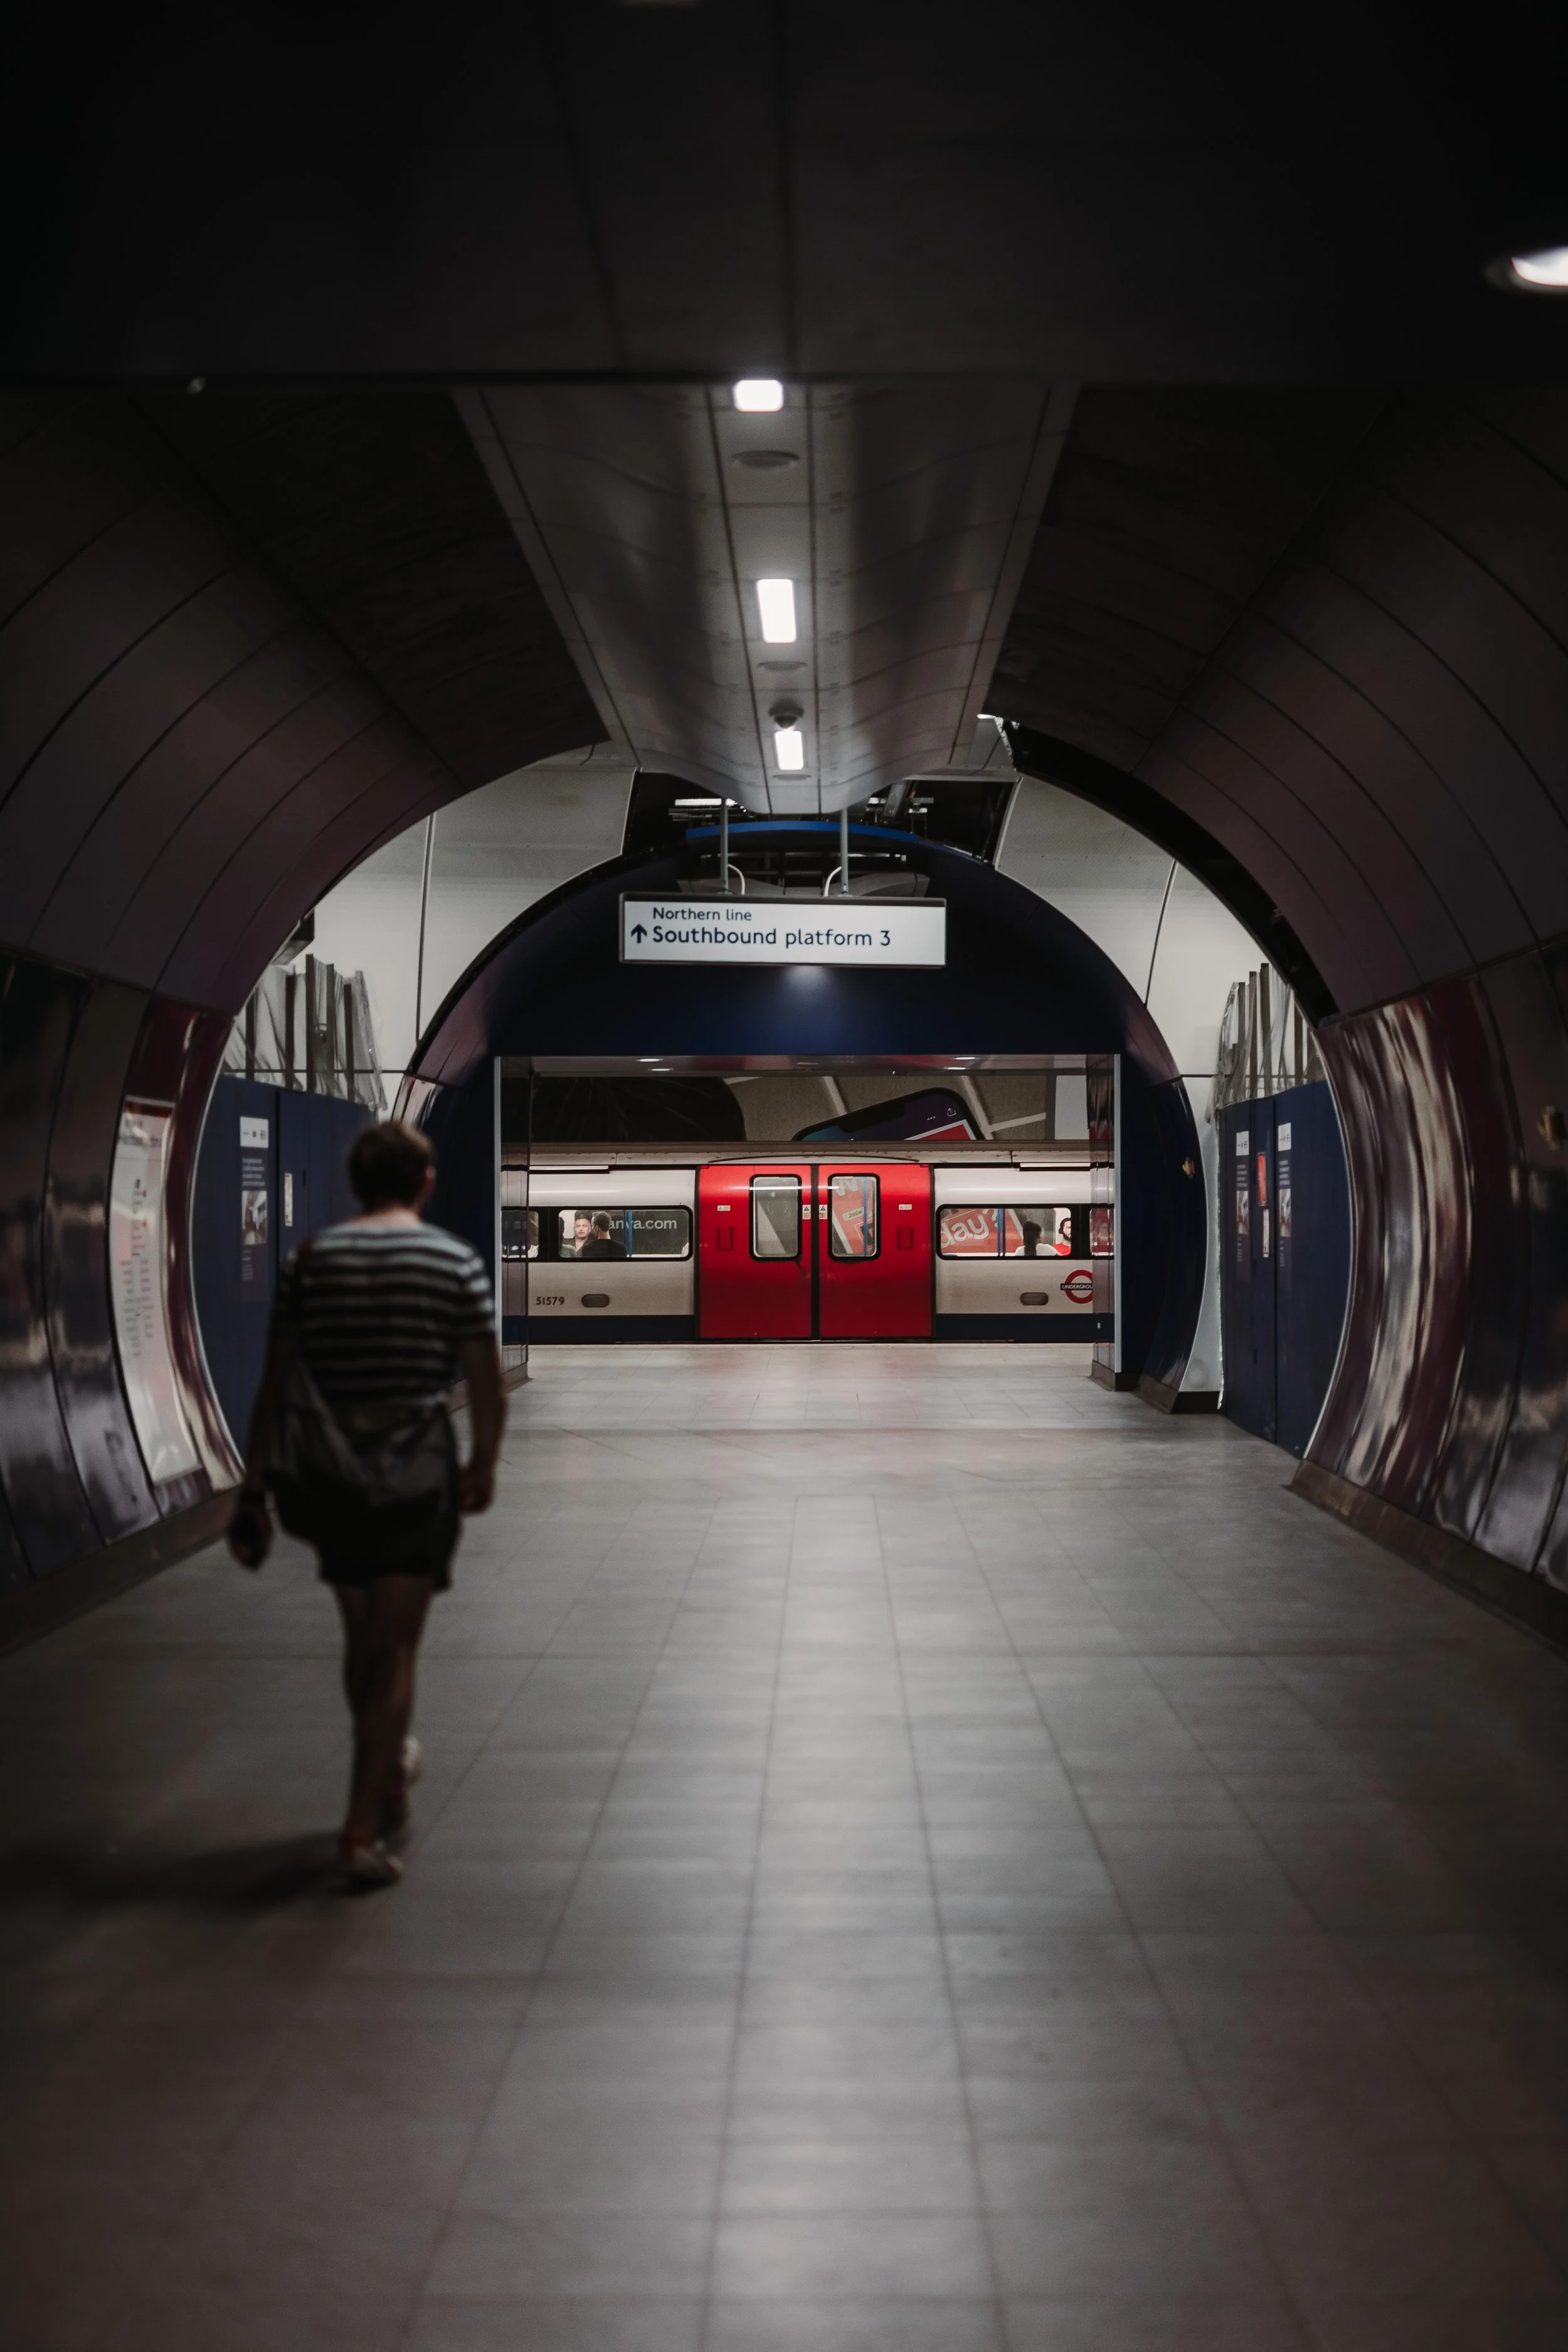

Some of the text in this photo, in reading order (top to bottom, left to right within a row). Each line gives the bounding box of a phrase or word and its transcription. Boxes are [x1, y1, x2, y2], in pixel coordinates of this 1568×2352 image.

[653, 907, 753, 921] Northern line
[652, 925, 891, 949] Southbound platform 3
[608, 1219, 677, 1230] anva.com
[536, 1296, 565, 1306] 51579
